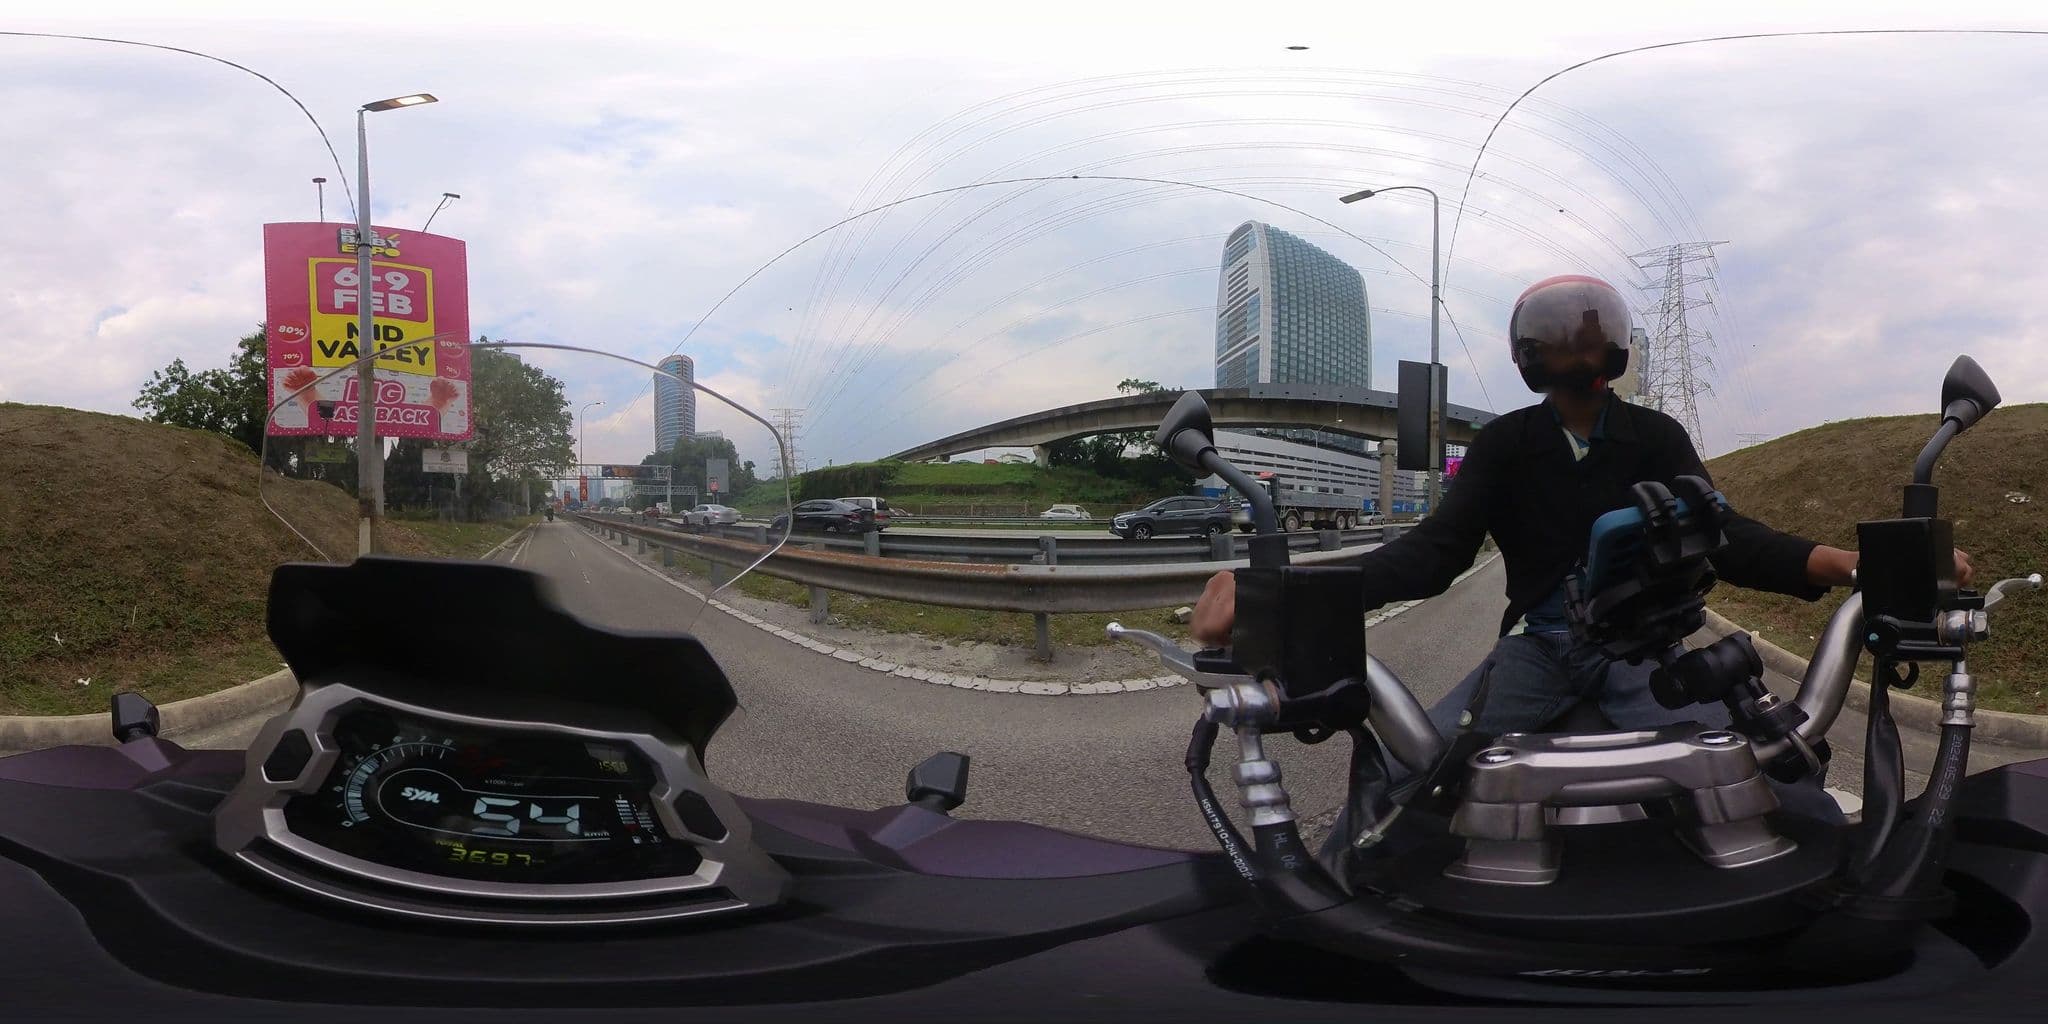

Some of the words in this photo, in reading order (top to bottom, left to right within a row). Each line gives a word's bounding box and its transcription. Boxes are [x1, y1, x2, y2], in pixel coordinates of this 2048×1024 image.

[341, 243, 400, 257] EPO
[317, 339, 430, 366] VALEY
[333, 406, 431, 426] ASBACK
[401, 786, 440, 804] SYM
[472, 796, 580, 837] 54
